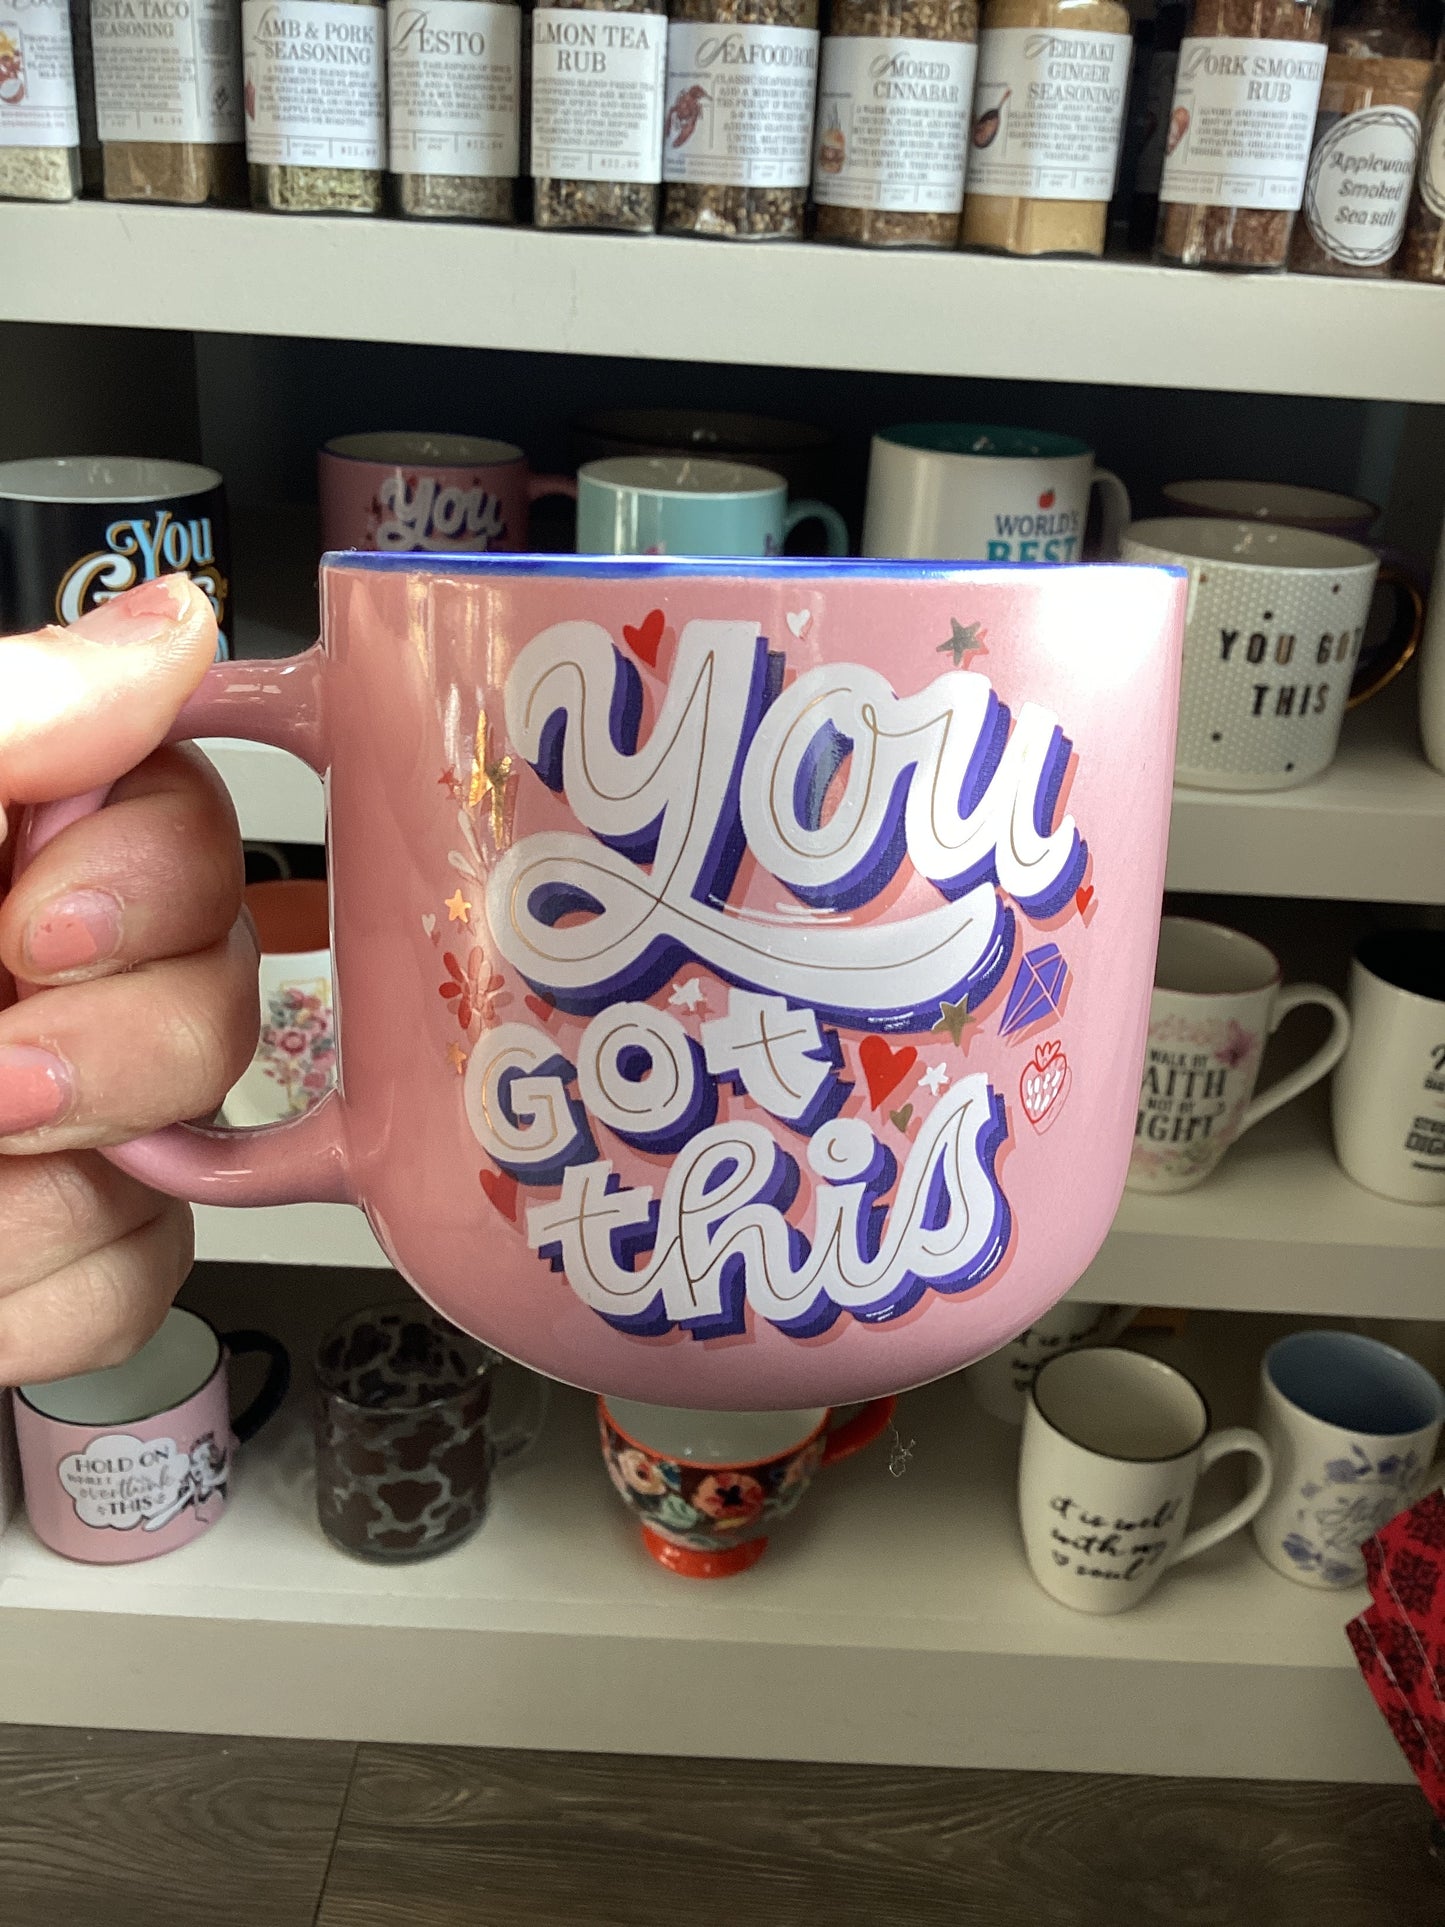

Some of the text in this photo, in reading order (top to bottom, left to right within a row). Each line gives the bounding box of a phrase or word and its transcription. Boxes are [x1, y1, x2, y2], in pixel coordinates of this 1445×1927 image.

[140, 0, 190, 19] TACO
[325, 22, 374, 43] PORK
[391, 8, 485, 57] PESTO
[602, 24, 650, 49] TEA
[264, 41, 371, 65] SEASONING
[557, 49, 606, 73] RUB
[869, 51, 950, 81] SMOKED
[1047, 62, 1110, 83] GINGER
[873, 80, 959, 103] CINNABAR
[1028, 82, 1120, 104] SEASONING
[1247, 80, 1292, 103] RUB
[1338, 178, 1404, 201] Smoked
[1335, 206, 1367, 226] Sea
[1220, 628, 1295, 666] YOU
[1252, 683, 1330, 717] THIS
[1141, 1066, 1227, 1099] AITH
[1135, 1110, 1213, 1142] IGHT
[75, 1446, 169, 1474] HOLD ON
[109, 1498, 153, 1516] THIS
[1051, 1528, 1127, 1557] with
[1075, 1557, 1144, 1581] soul
